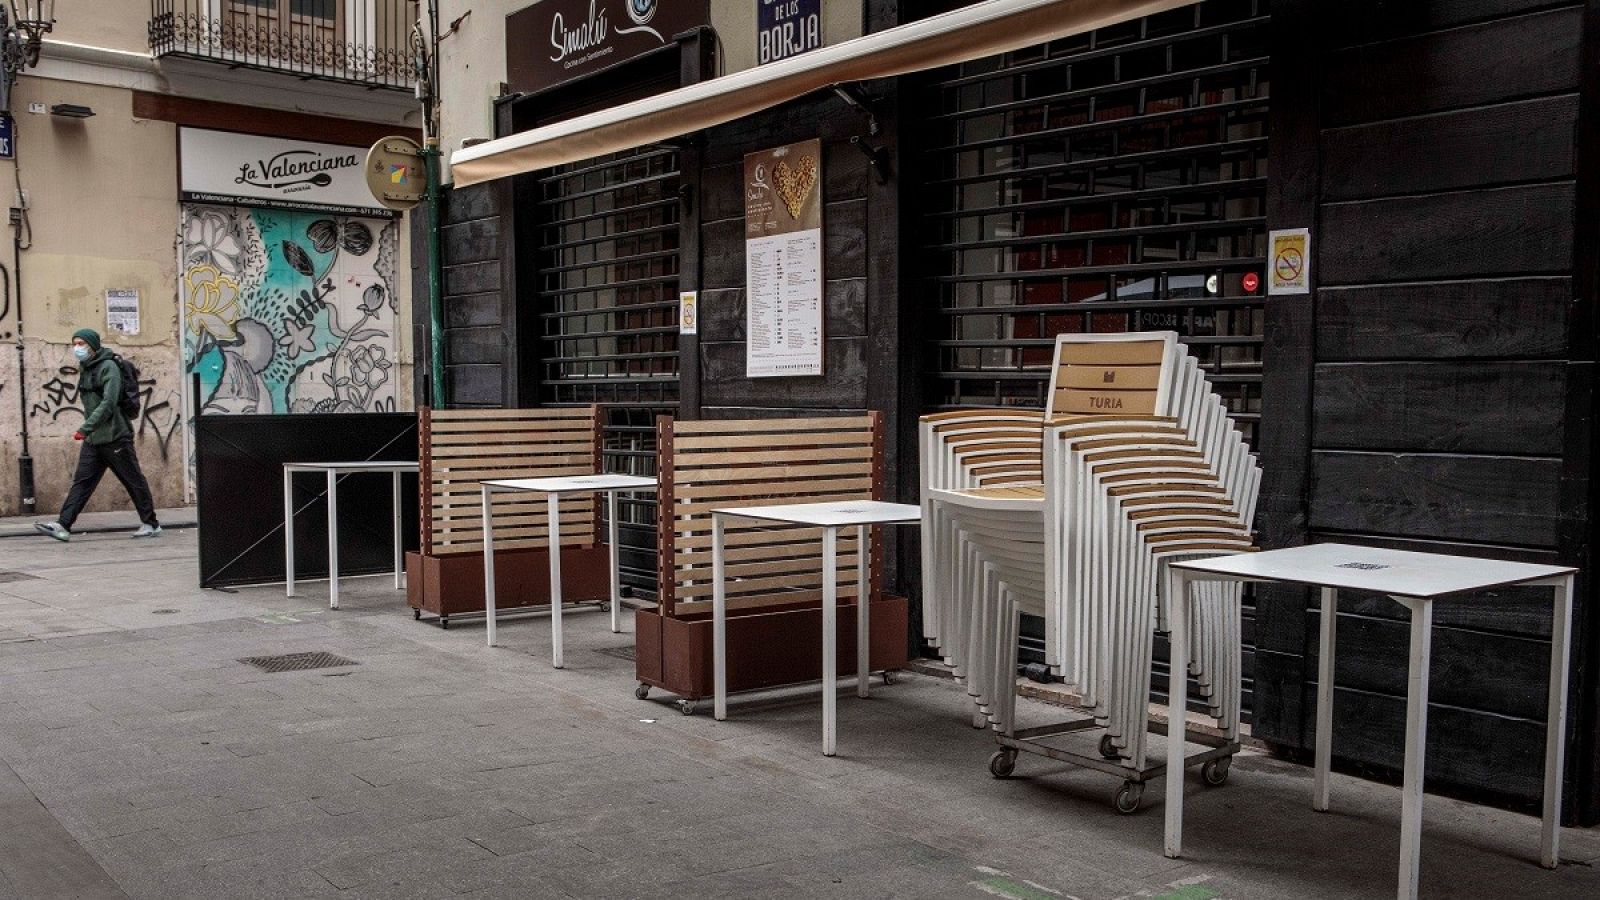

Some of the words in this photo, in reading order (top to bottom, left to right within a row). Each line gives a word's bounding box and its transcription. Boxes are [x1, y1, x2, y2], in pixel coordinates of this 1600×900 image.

[775, 5, 785, 20] DE
[786, 0, 799, 17] LOS
[550, 0, 608, 62] Simalú
[760, 14, 818, 64] BORJA
[234, 163, 258, 184] La
[258, 150, 359, 180] Valenciana
[201, 194, 234, 202] Valenciana
[1089, 396, 1123, 409] TURIA
